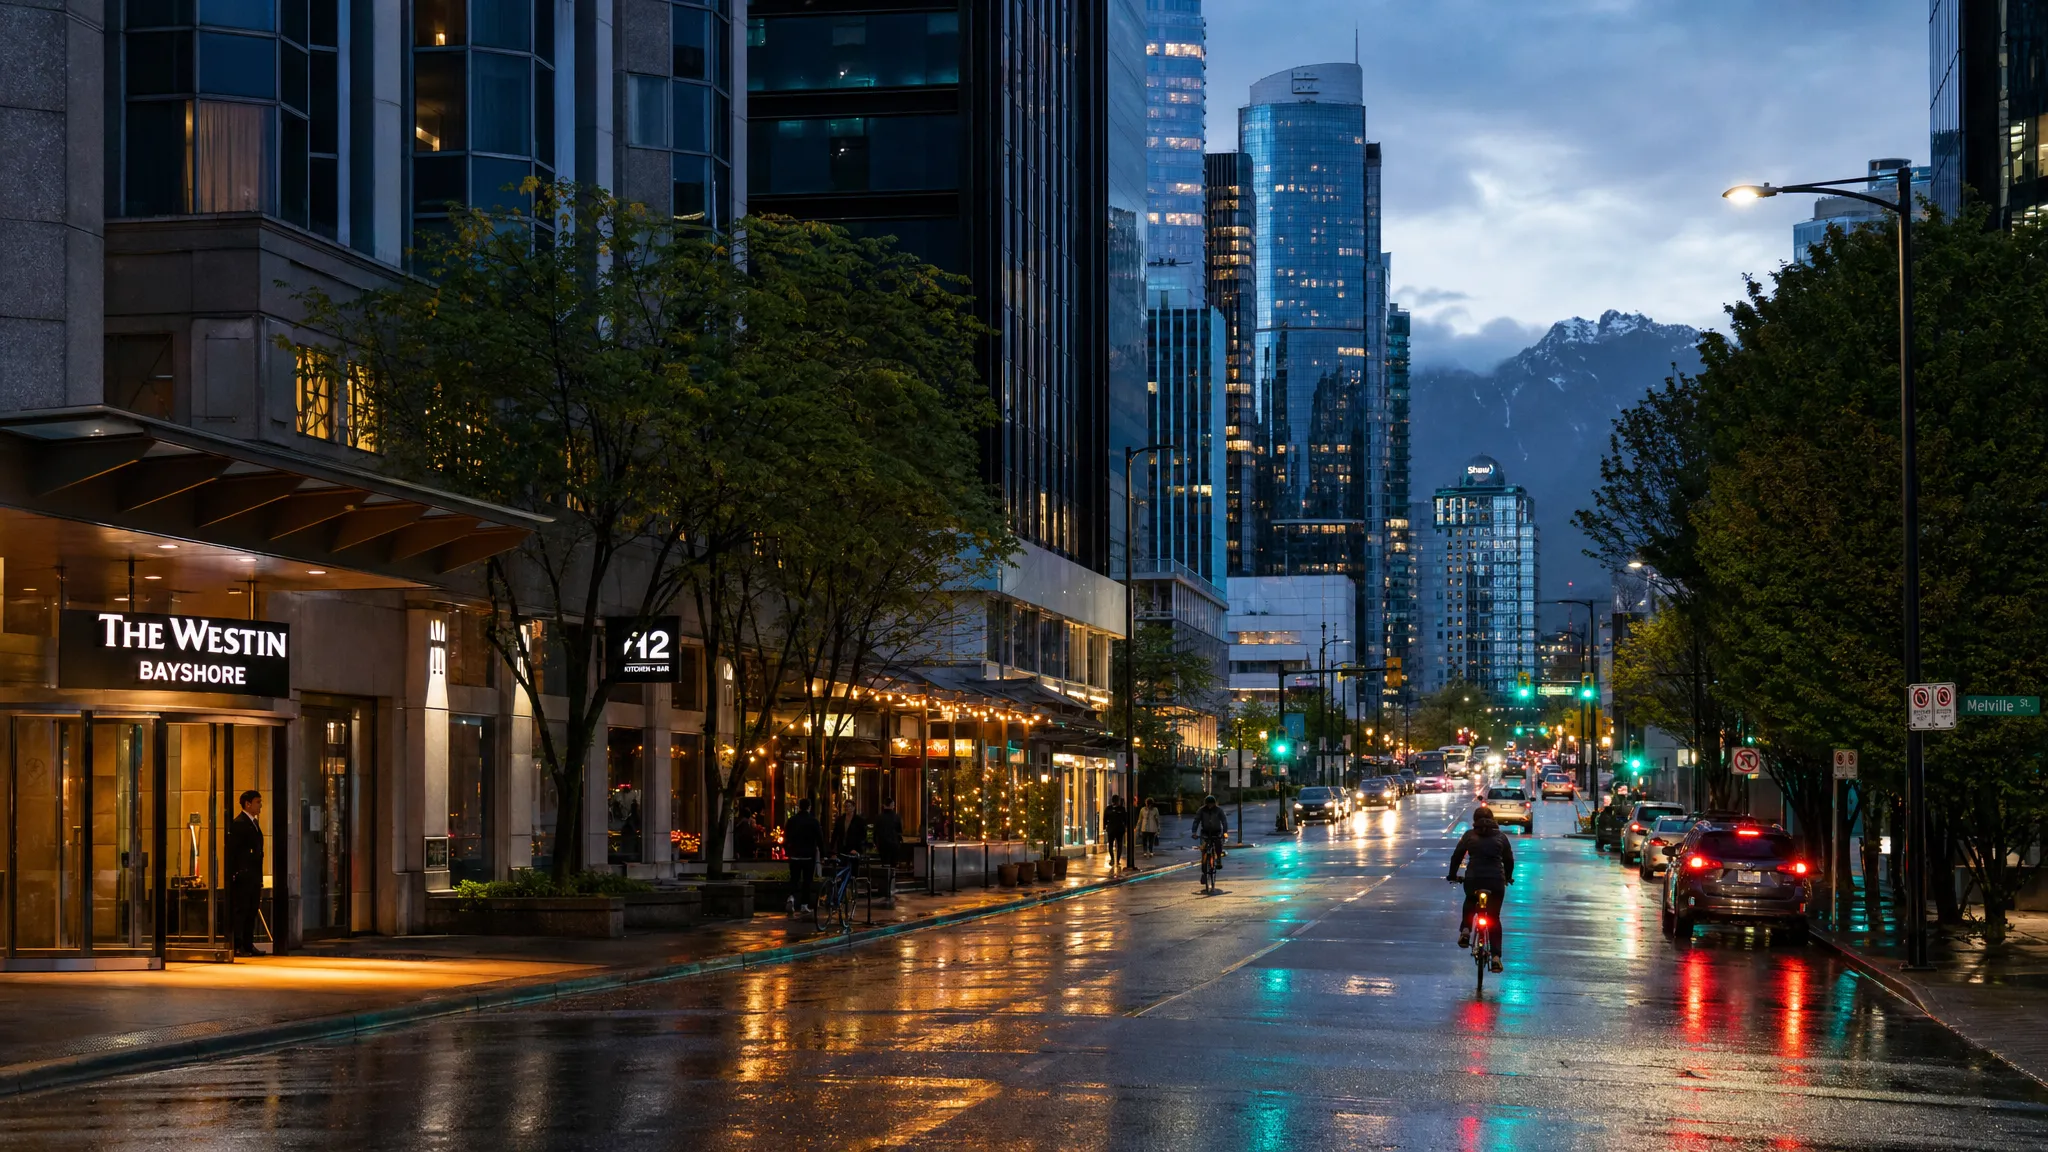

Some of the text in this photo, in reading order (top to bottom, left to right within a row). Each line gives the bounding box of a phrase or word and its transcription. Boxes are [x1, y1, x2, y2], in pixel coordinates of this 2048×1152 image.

[98, 613, 287, 658] THE WESTIN
[140, 660, 247, 685] BAYSHORE
[1967, 699, 2014, 712] Melville
